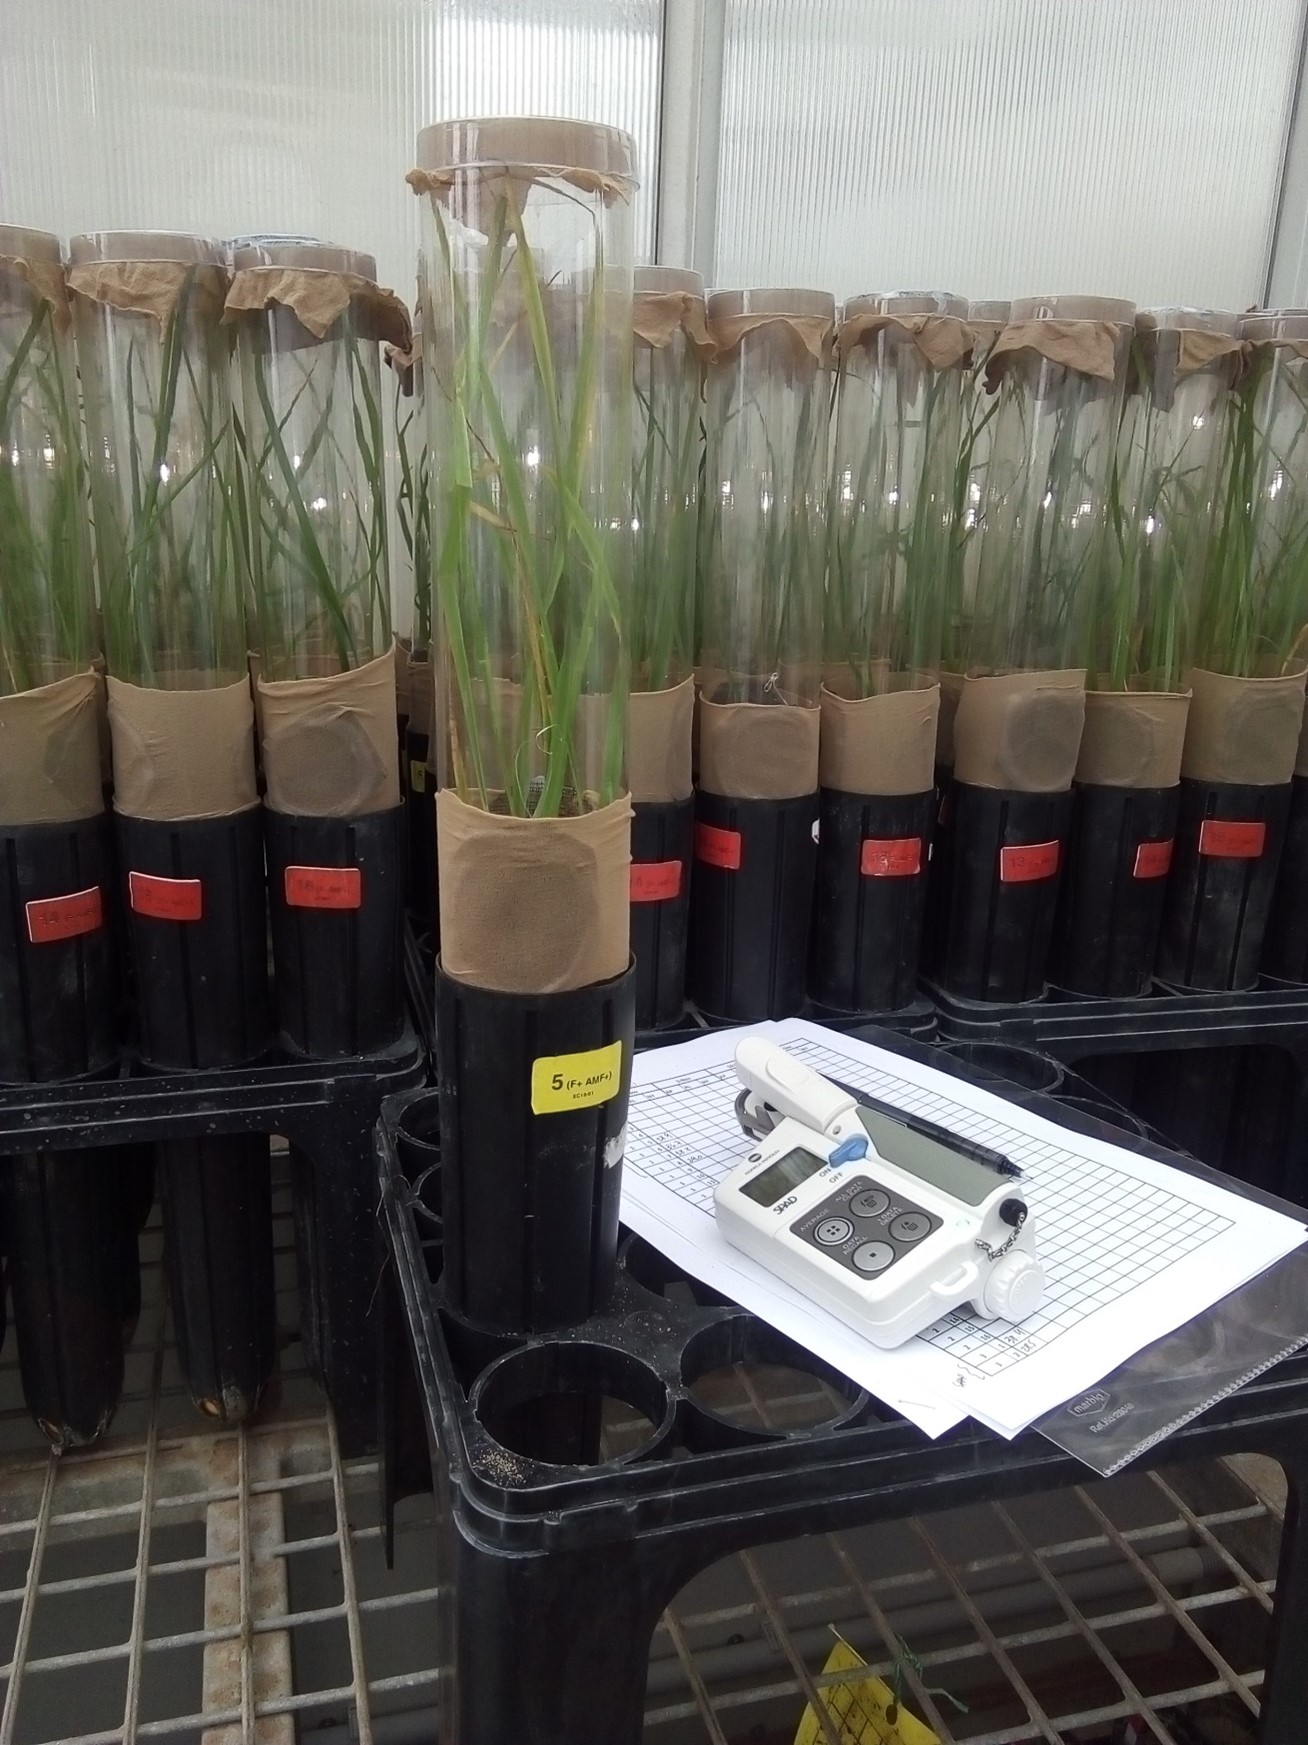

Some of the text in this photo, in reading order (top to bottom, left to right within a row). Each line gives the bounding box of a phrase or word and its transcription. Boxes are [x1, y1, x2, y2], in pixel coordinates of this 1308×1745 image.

[551, 1070, 612, 1091] 5 (F+ AMF+)
[819, 1167, 832, 1178] ON
[829, 1171, 844, 1184] OFF
[773, 1195, 798, 1215] SPAD
[881, 1206, 899, 1220] DATA
[800, 1208, 830, 1232] AVERAGE
[842, 1235, 861, 1250] DATA
[843, 1236, 869, 1255] RECALL
[1073, 1392, 1105, 1414] marbig
